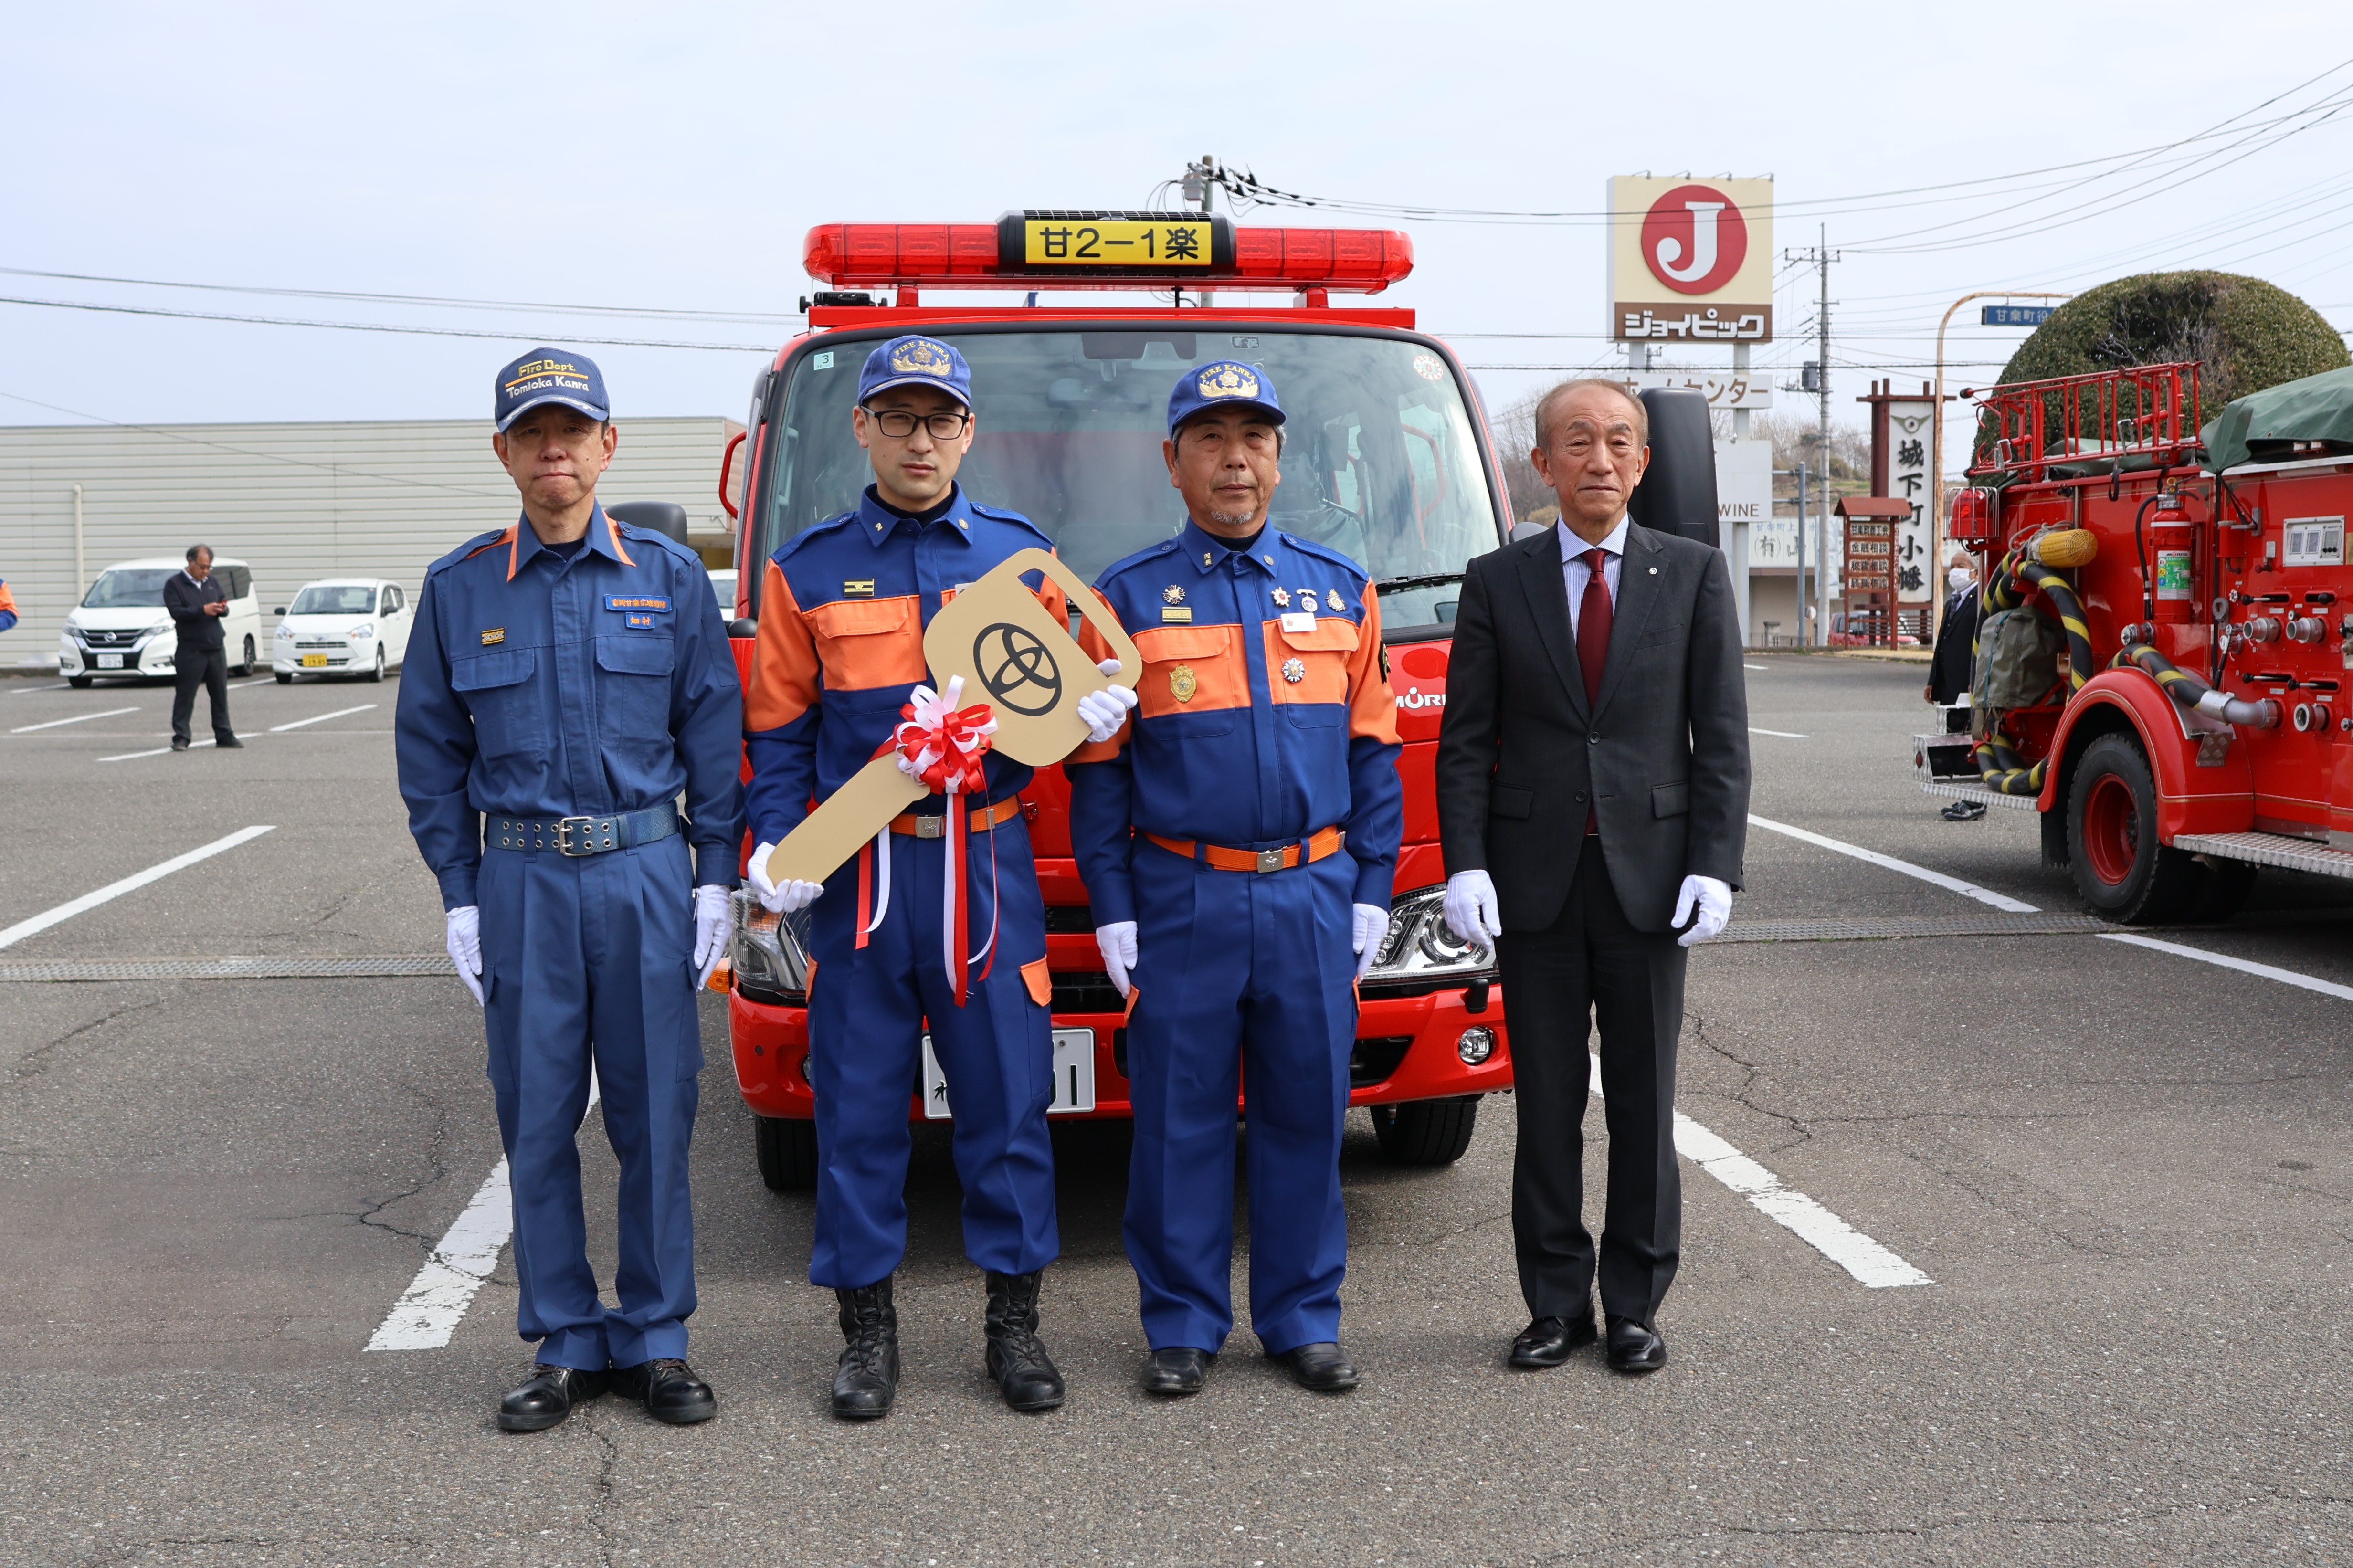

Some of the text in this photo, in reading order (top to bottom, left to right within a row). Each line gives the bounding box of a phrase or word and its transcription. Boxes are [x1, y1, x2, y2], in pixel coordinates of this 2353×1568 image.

[1656, 201, 1726, 282] J
[1625, 307, 1765, 338] ジョイピック
[894, 341, 949, 359] FIRE KANRA
[543, 359, 576, 372] Dept.
[823, 355, 829, 364] 3
[1200, 365, 1256, 381] FIRE KANRA
[506, 375, 589, 399] Tomioka Kanra
